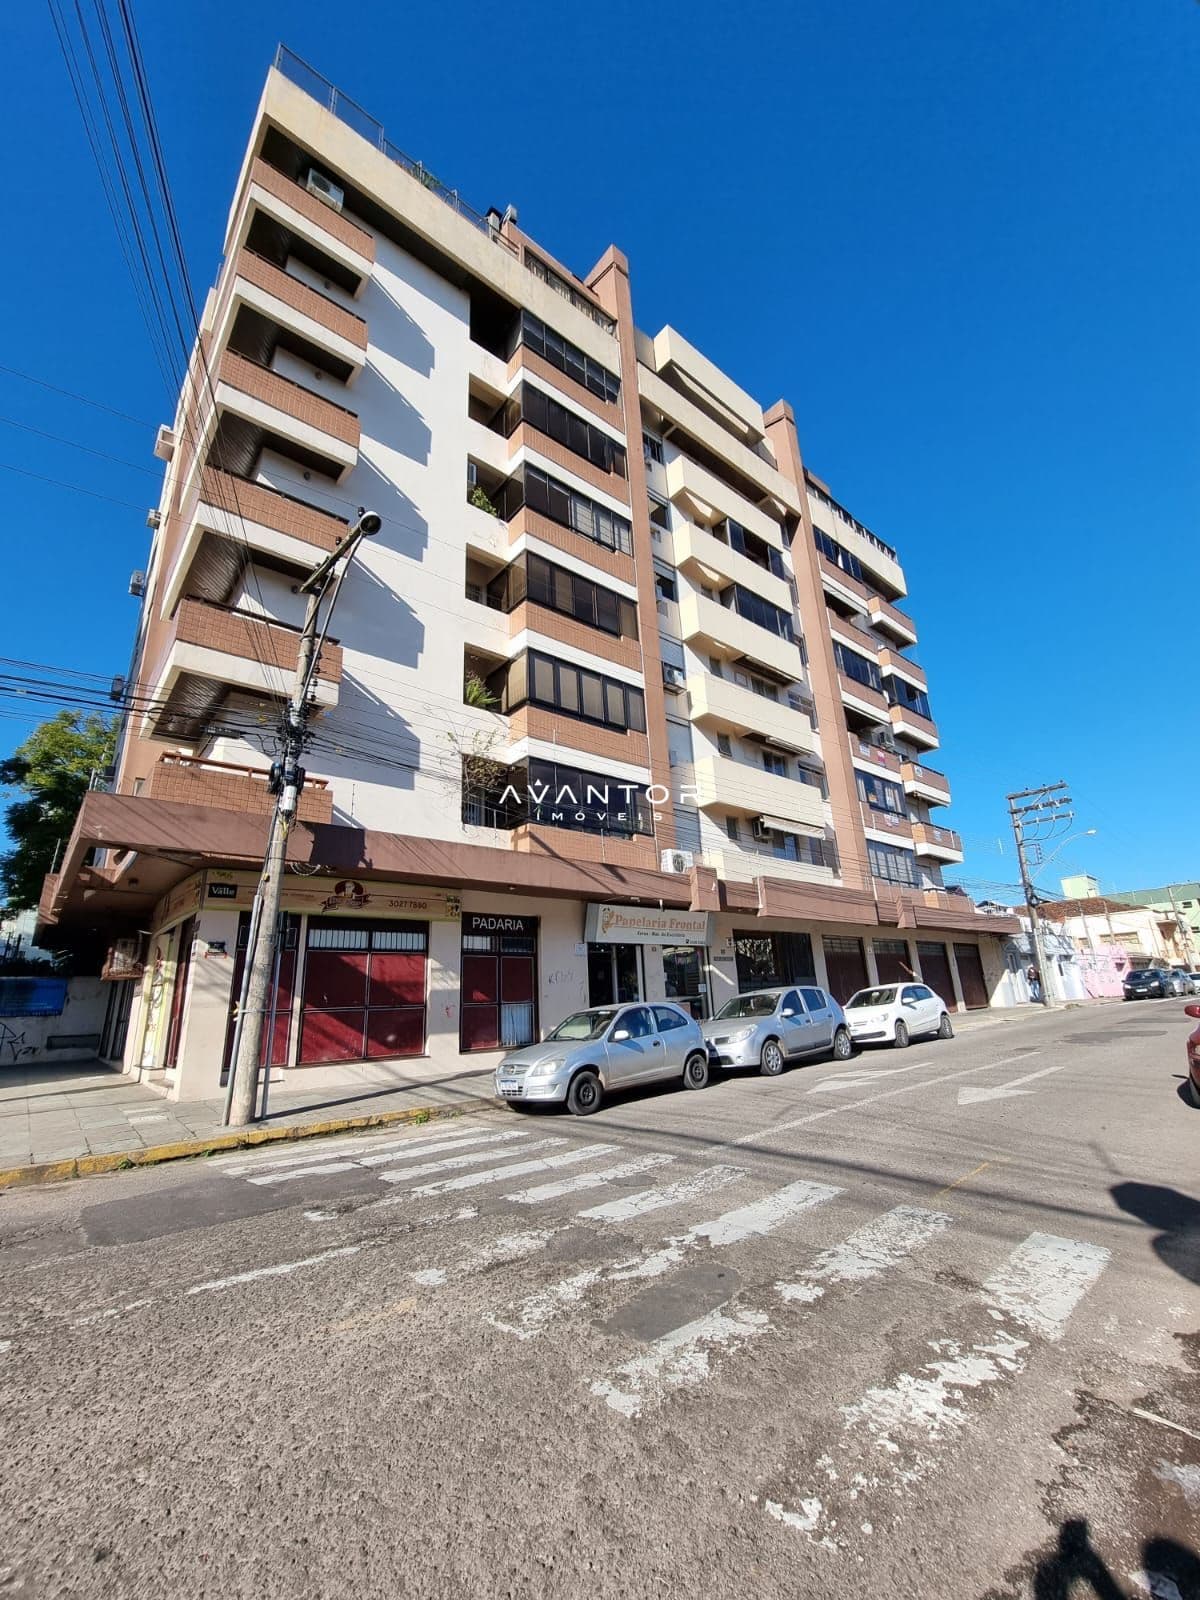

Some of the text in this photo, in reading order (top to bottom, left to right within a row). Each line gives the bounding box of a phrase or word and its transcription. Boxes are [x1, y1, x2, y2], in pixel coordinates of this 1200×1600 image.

[472, 916, 525, 931] PADARIA
[615, 914, 706, 930] Papelaria Frontal
